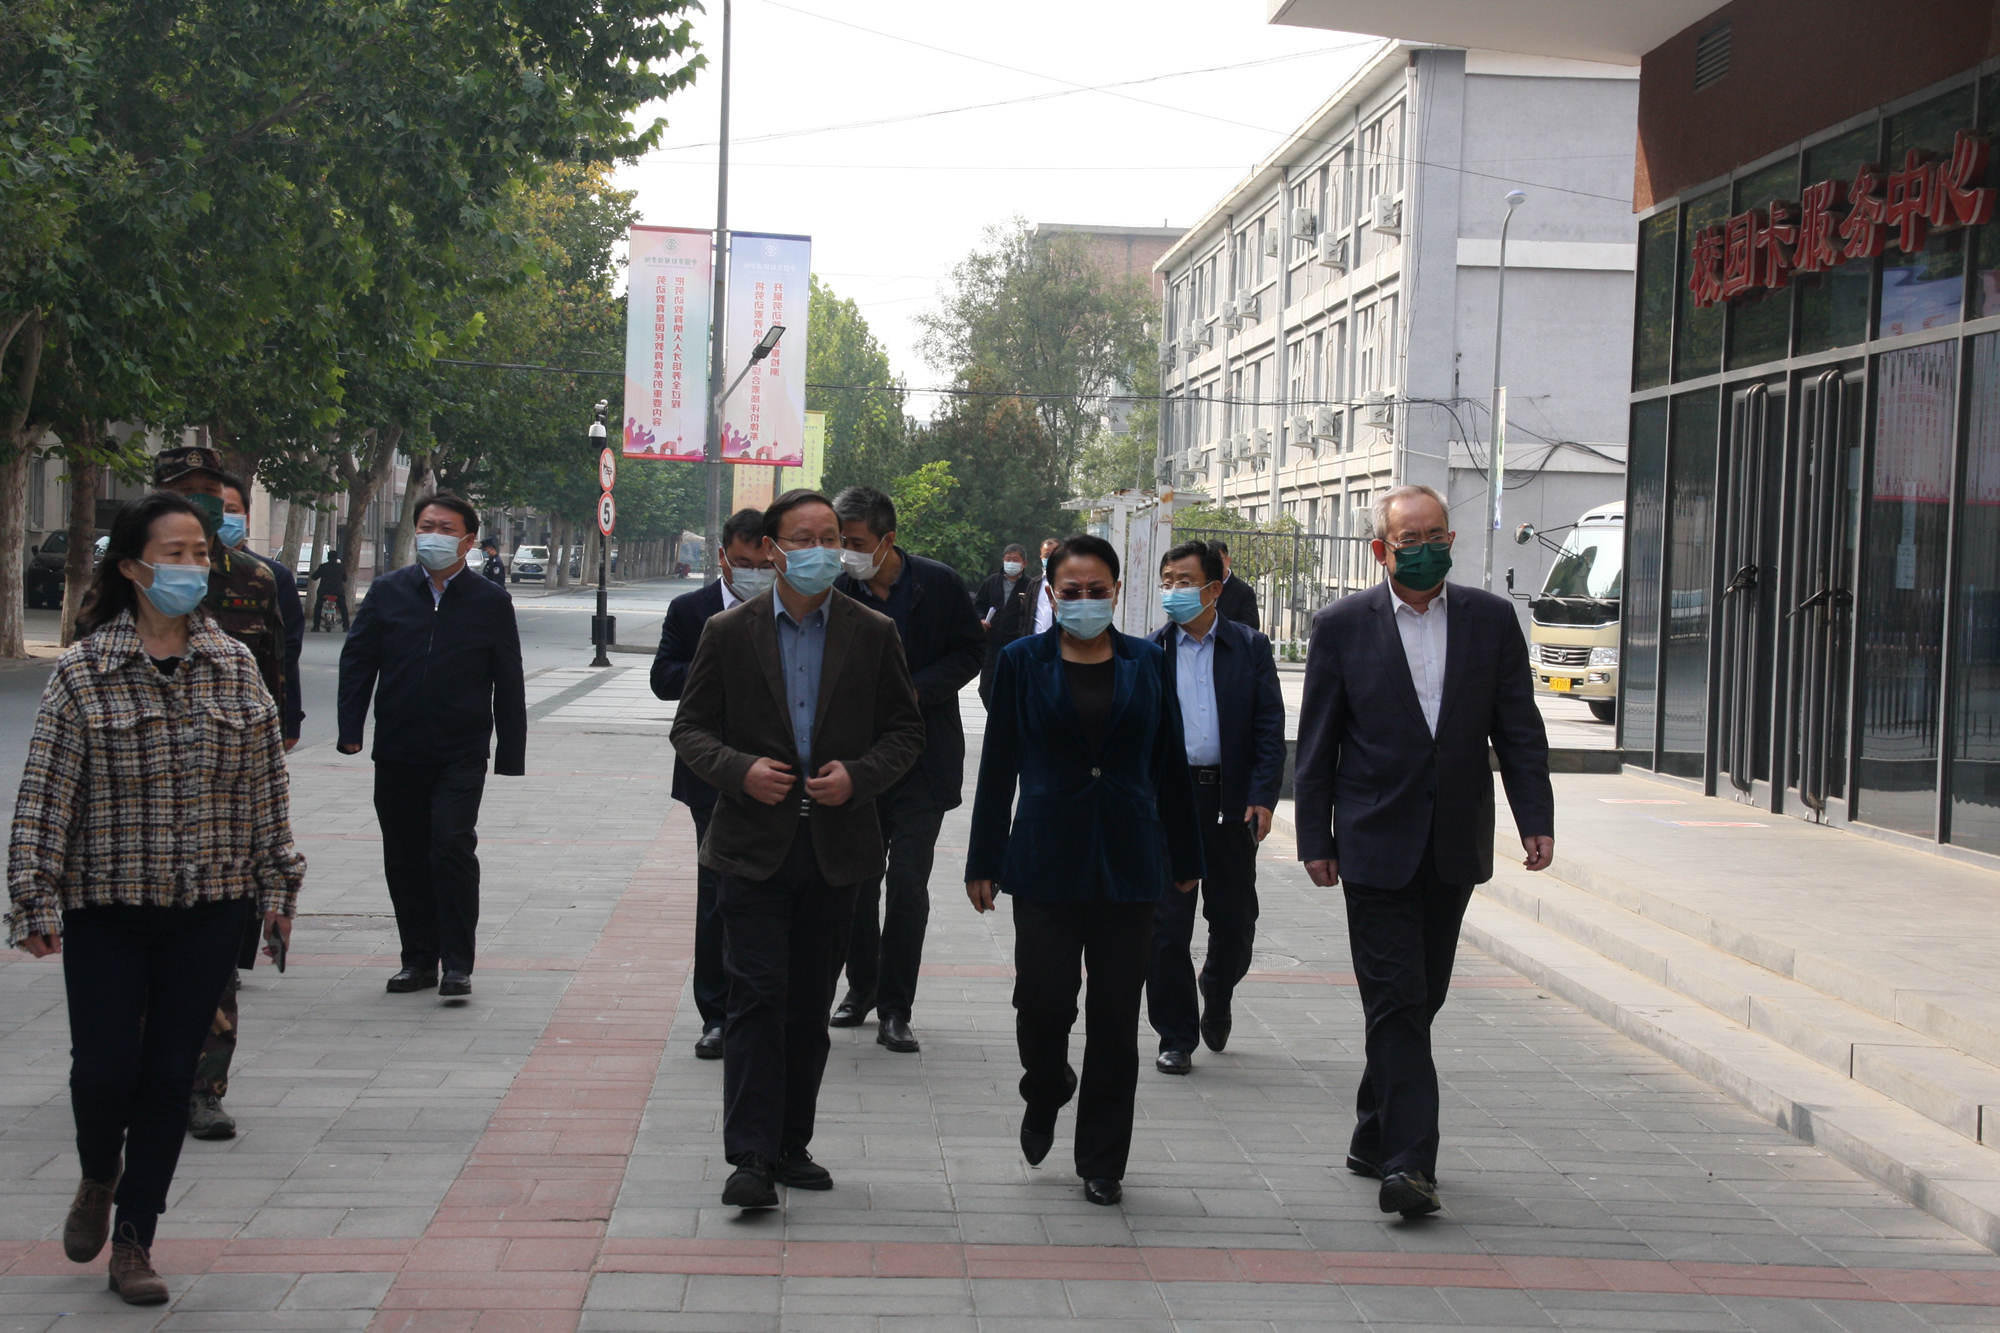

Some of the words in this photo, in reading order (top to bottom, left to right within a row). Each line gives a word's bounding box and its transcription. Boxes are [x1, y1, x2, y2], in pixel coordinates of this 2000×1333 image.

[1688, 128, 1996, 308] 校园卡服务中心
[603, 502, 611, 525] 5
